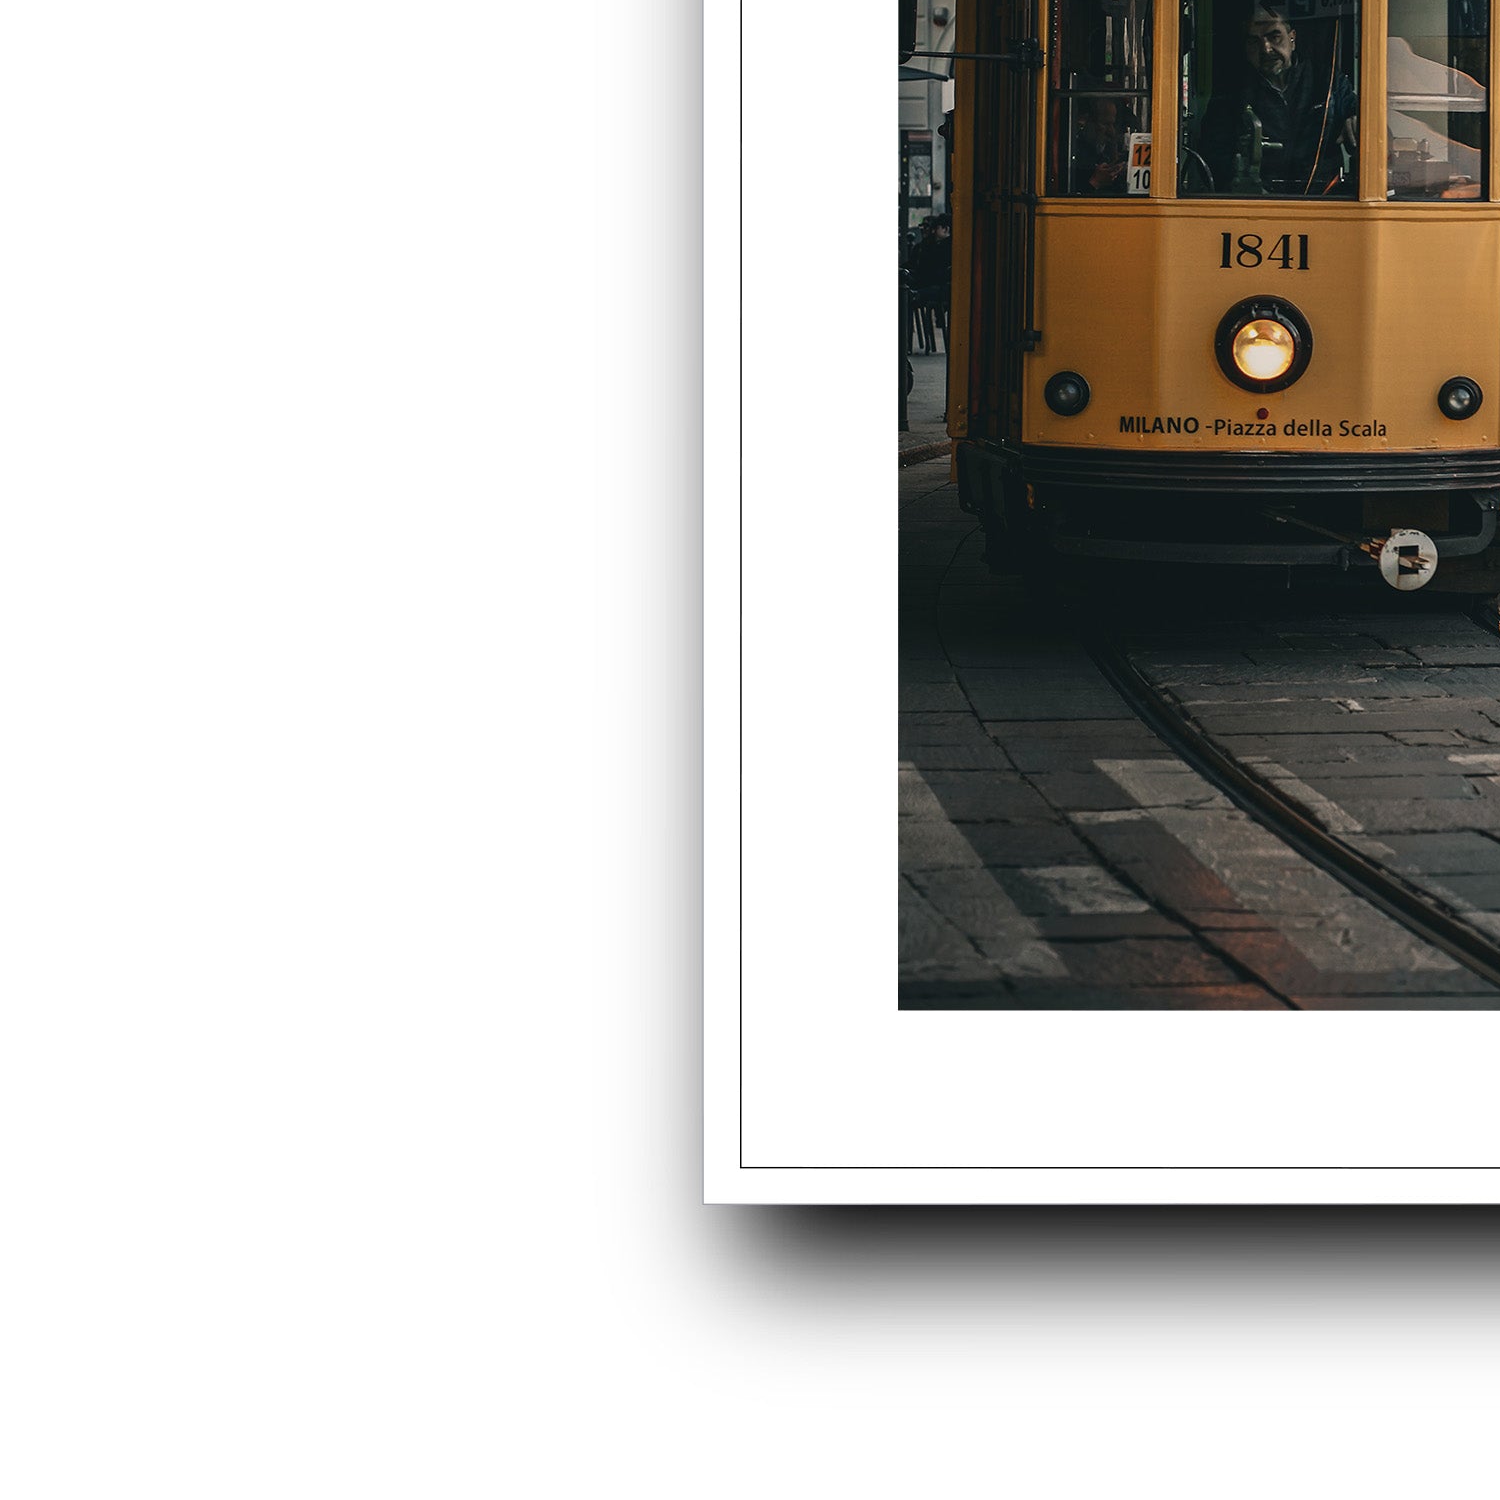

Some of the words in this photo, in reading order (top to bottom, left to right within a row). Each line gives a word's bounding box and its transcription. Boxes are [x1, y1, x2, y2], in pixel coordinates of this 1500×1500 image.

[1133, 169, 1151, 189] 10
[1219, 232, 1310, 270] 1841
[1119, 416, 1199, 434] MILANO
[1283, 419, 1332, 436] della
[1339, 420, 1387, 437] Scala
